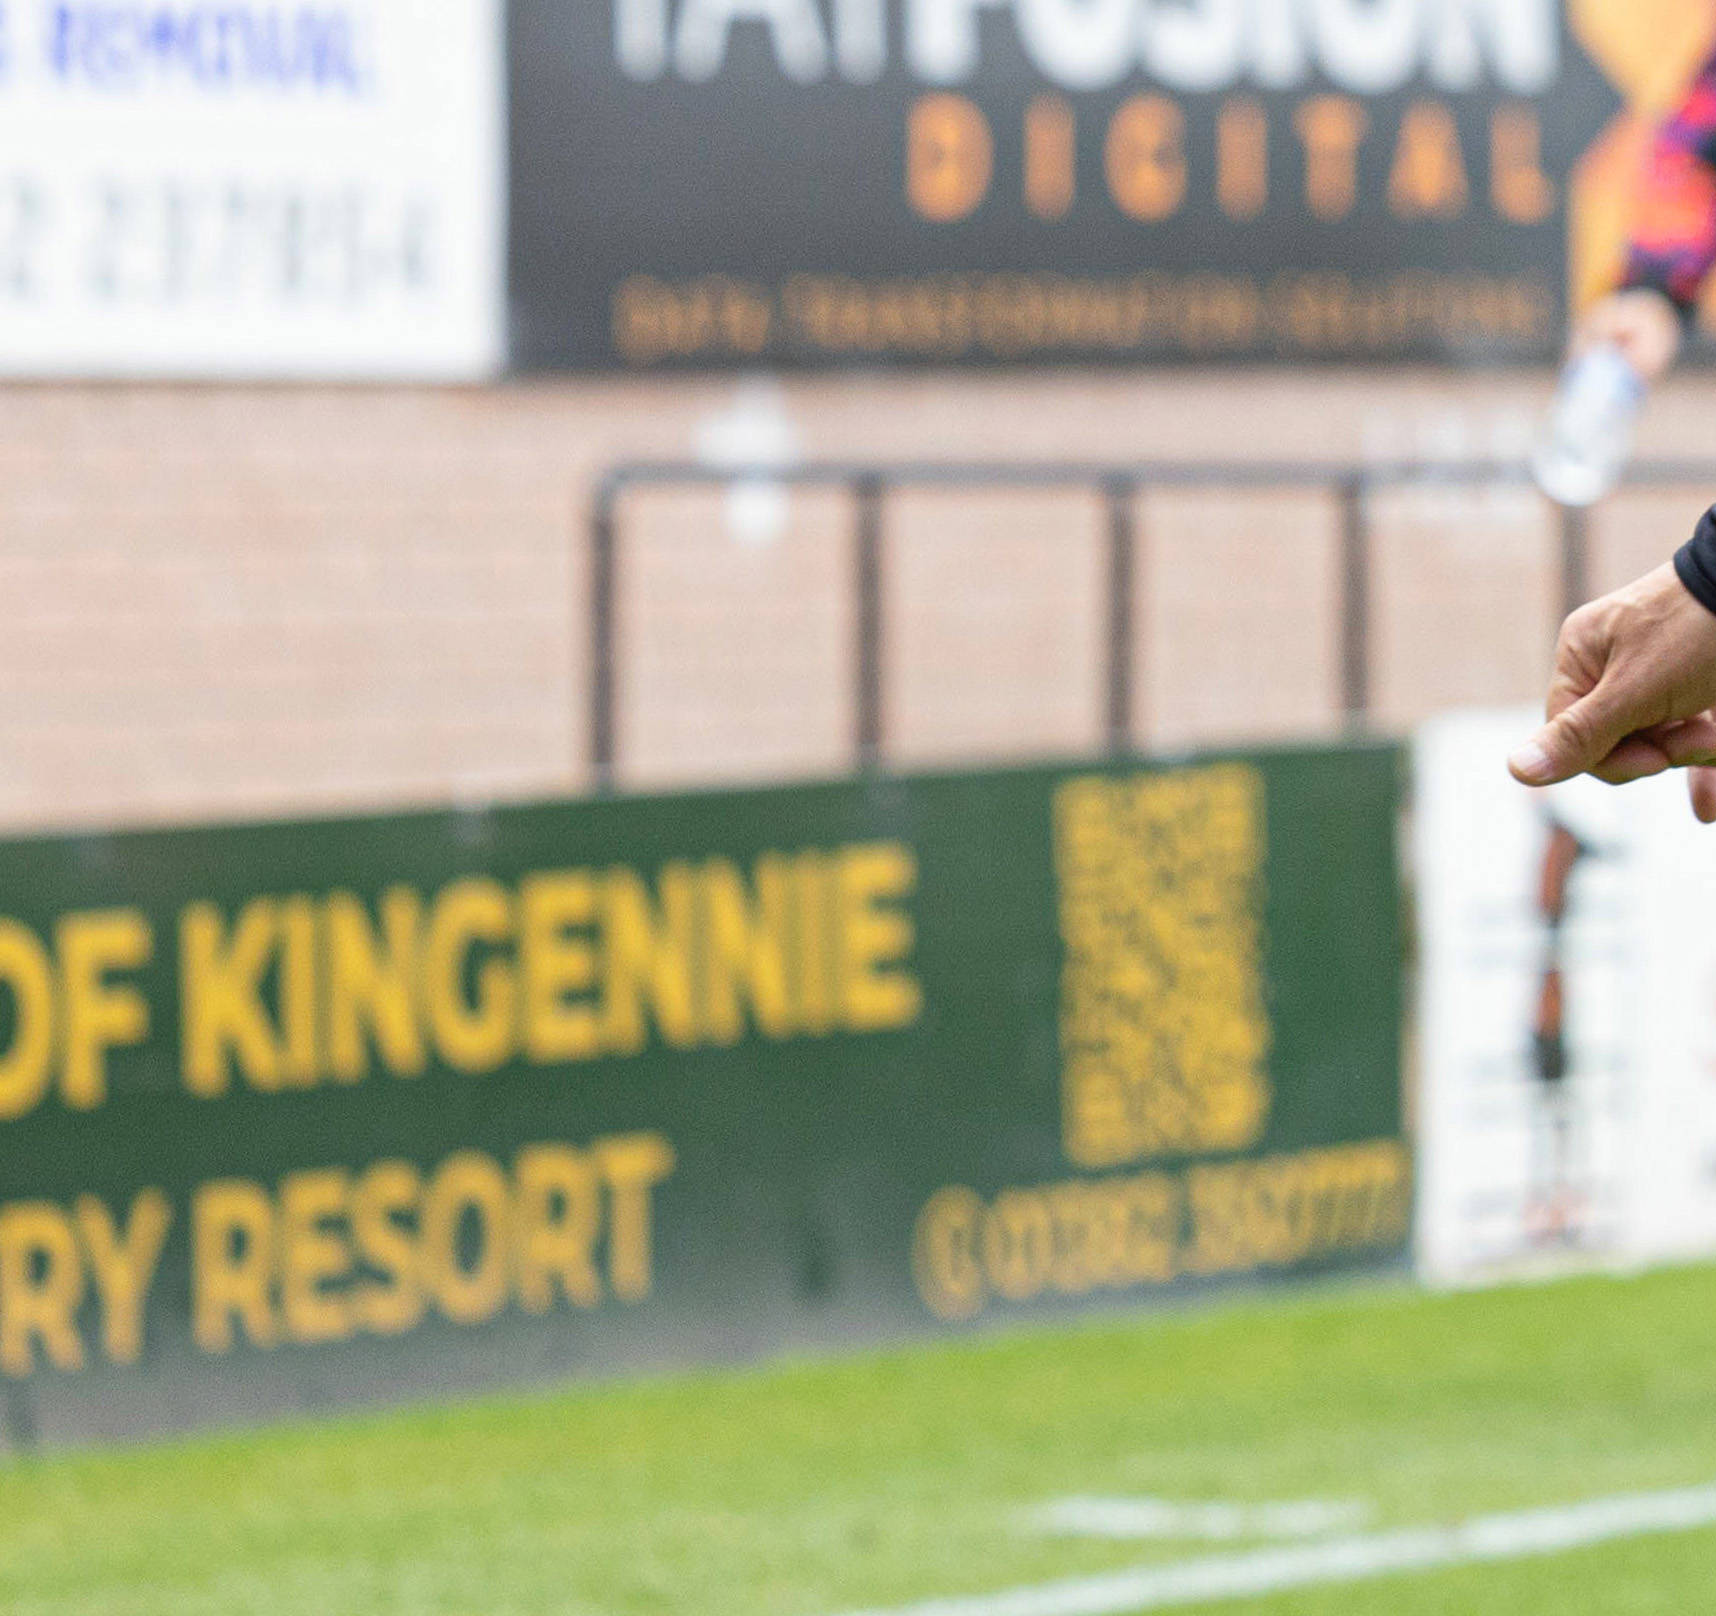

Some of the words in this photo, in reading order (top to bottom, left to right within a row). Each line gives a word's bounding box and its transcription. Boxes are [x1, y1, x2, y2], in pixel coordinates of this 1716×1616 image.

[905, 90, 1553, 224] DIGITAL
[0, 904, 152, 1122] OF
[178, 839, 924, 1102] KINGENNIE
[191, 1129, 674, 1357] RESORT
